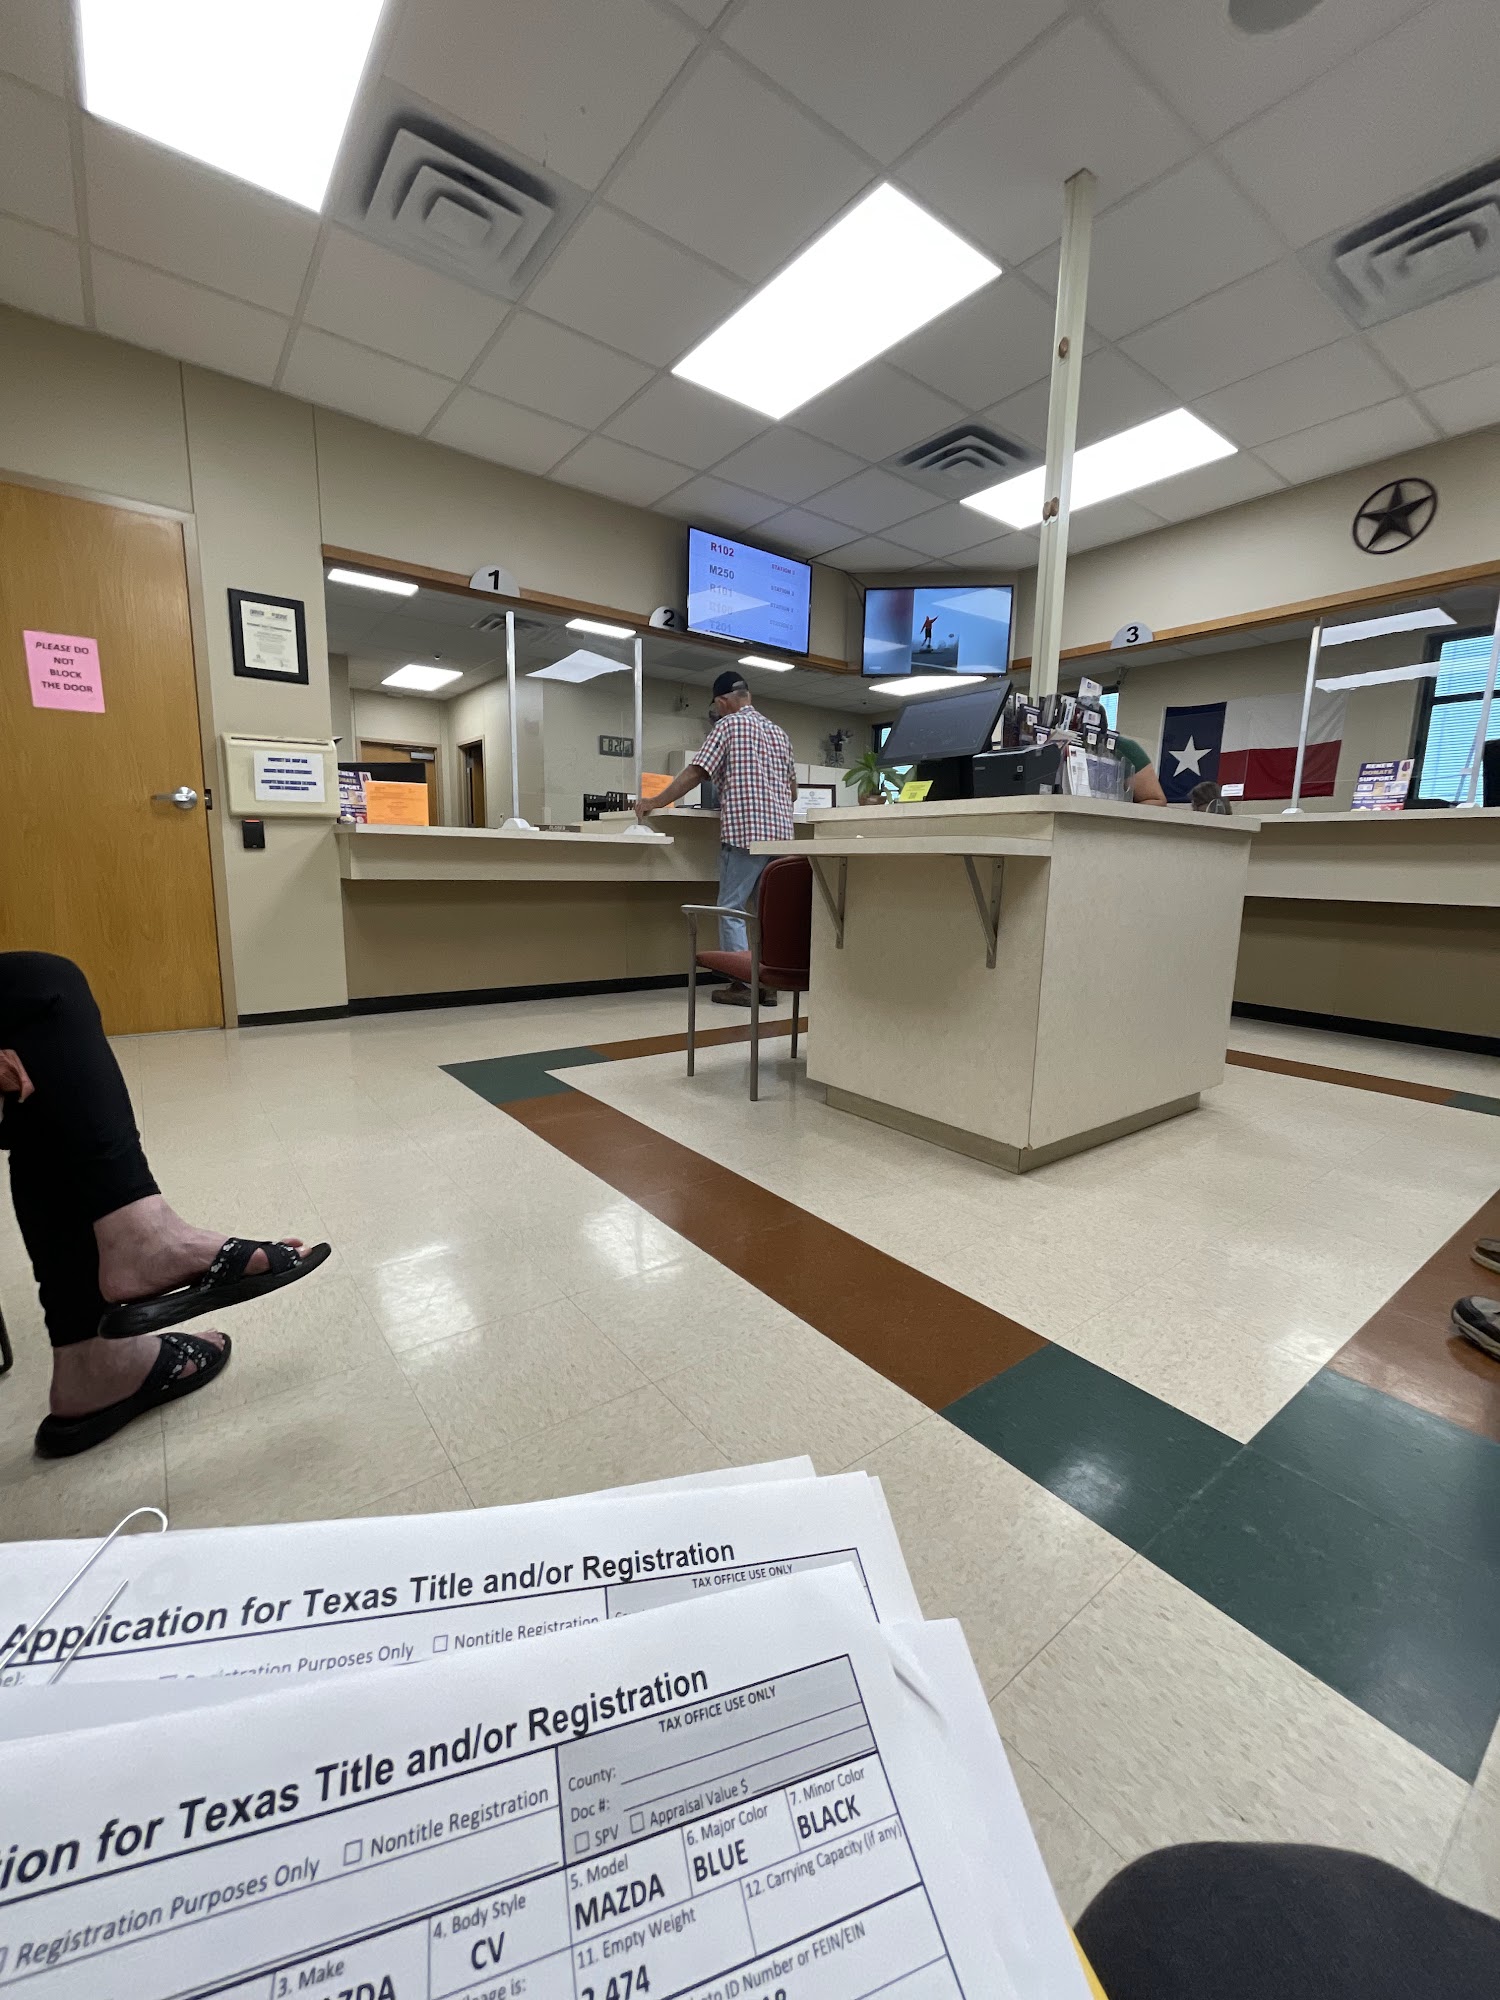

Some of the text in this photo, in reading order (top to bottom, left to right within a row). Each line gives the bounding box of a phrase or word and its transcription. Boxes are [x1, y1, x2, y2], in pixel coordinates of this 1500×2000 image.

[710, 541, 735, 558] R102
[487, 570, 499, 590] 1
[709, 564, 735, 580] M250
[709, 583, 733, 598] R101
[663, 609, 675, 628] 2
[1126, 626, 1139, 643] 3
[35, 641, 90, 655] PLEASE DO
[53, 657, 75, 666] NOT
[41, 680, 94, 693] THE DOOR
[49, 668, 82, 679] BLOCK
[692, 1563, 794, 1589] TAX OFFICE USE ONLY
[0, 1541, 736, 1663] Application for Texas Title and/or Registration
[454, 1626, 514, 1650] Nontitle
[297, 1649, 373, 1673] Purposes
[378, 1642, 415, 1663] Only
[659, 1684, 778, 1733] TAX OFFICE USE ONLY
[0, 1668, 709, 1890] ion for Texas Title and/or Registration
[567, 1766, 617, 1792] County:
[788, 1766, 866, 1807] 7. Minor Color
[370, 1786, 550, 1858] Nontitle Registration
[570, 1798, 611, 1823] Doc #:
[649, 1778, 750, 1828] Appraisal Value $
[796, 1794, 862, 1840] BLACK
[594, 1823, 620, 1847] SPV
[686, 1803, 769, 1847] 6. Major Color
[570, 1853, 630, 1891] 5. Model
[692, 1838, 750, 1883] BLUE
[744, 1819, 904, 1899] 12. Carrying Capacity (if any)
[15, 1855, 321, 1971] Registration Purposes Only
[433, 1893, 527, 1940] 4. Body Style
[574, 1872, 666, 1931] MAZDA
[470, 1930, 505, 1971] CV
[577, 1907, 697, 1970] 11. Empty Weight
[277, 1958, 345, 1999] 3. Make
[724, 1979, 741, 2000] ID
[742, 1956, 795, 1992] Number
[797, 1947, 815, 1968] or
[811, 1920, 867, 1960] FEIN/EIN
[510, 1978, 527, 1996] is:
